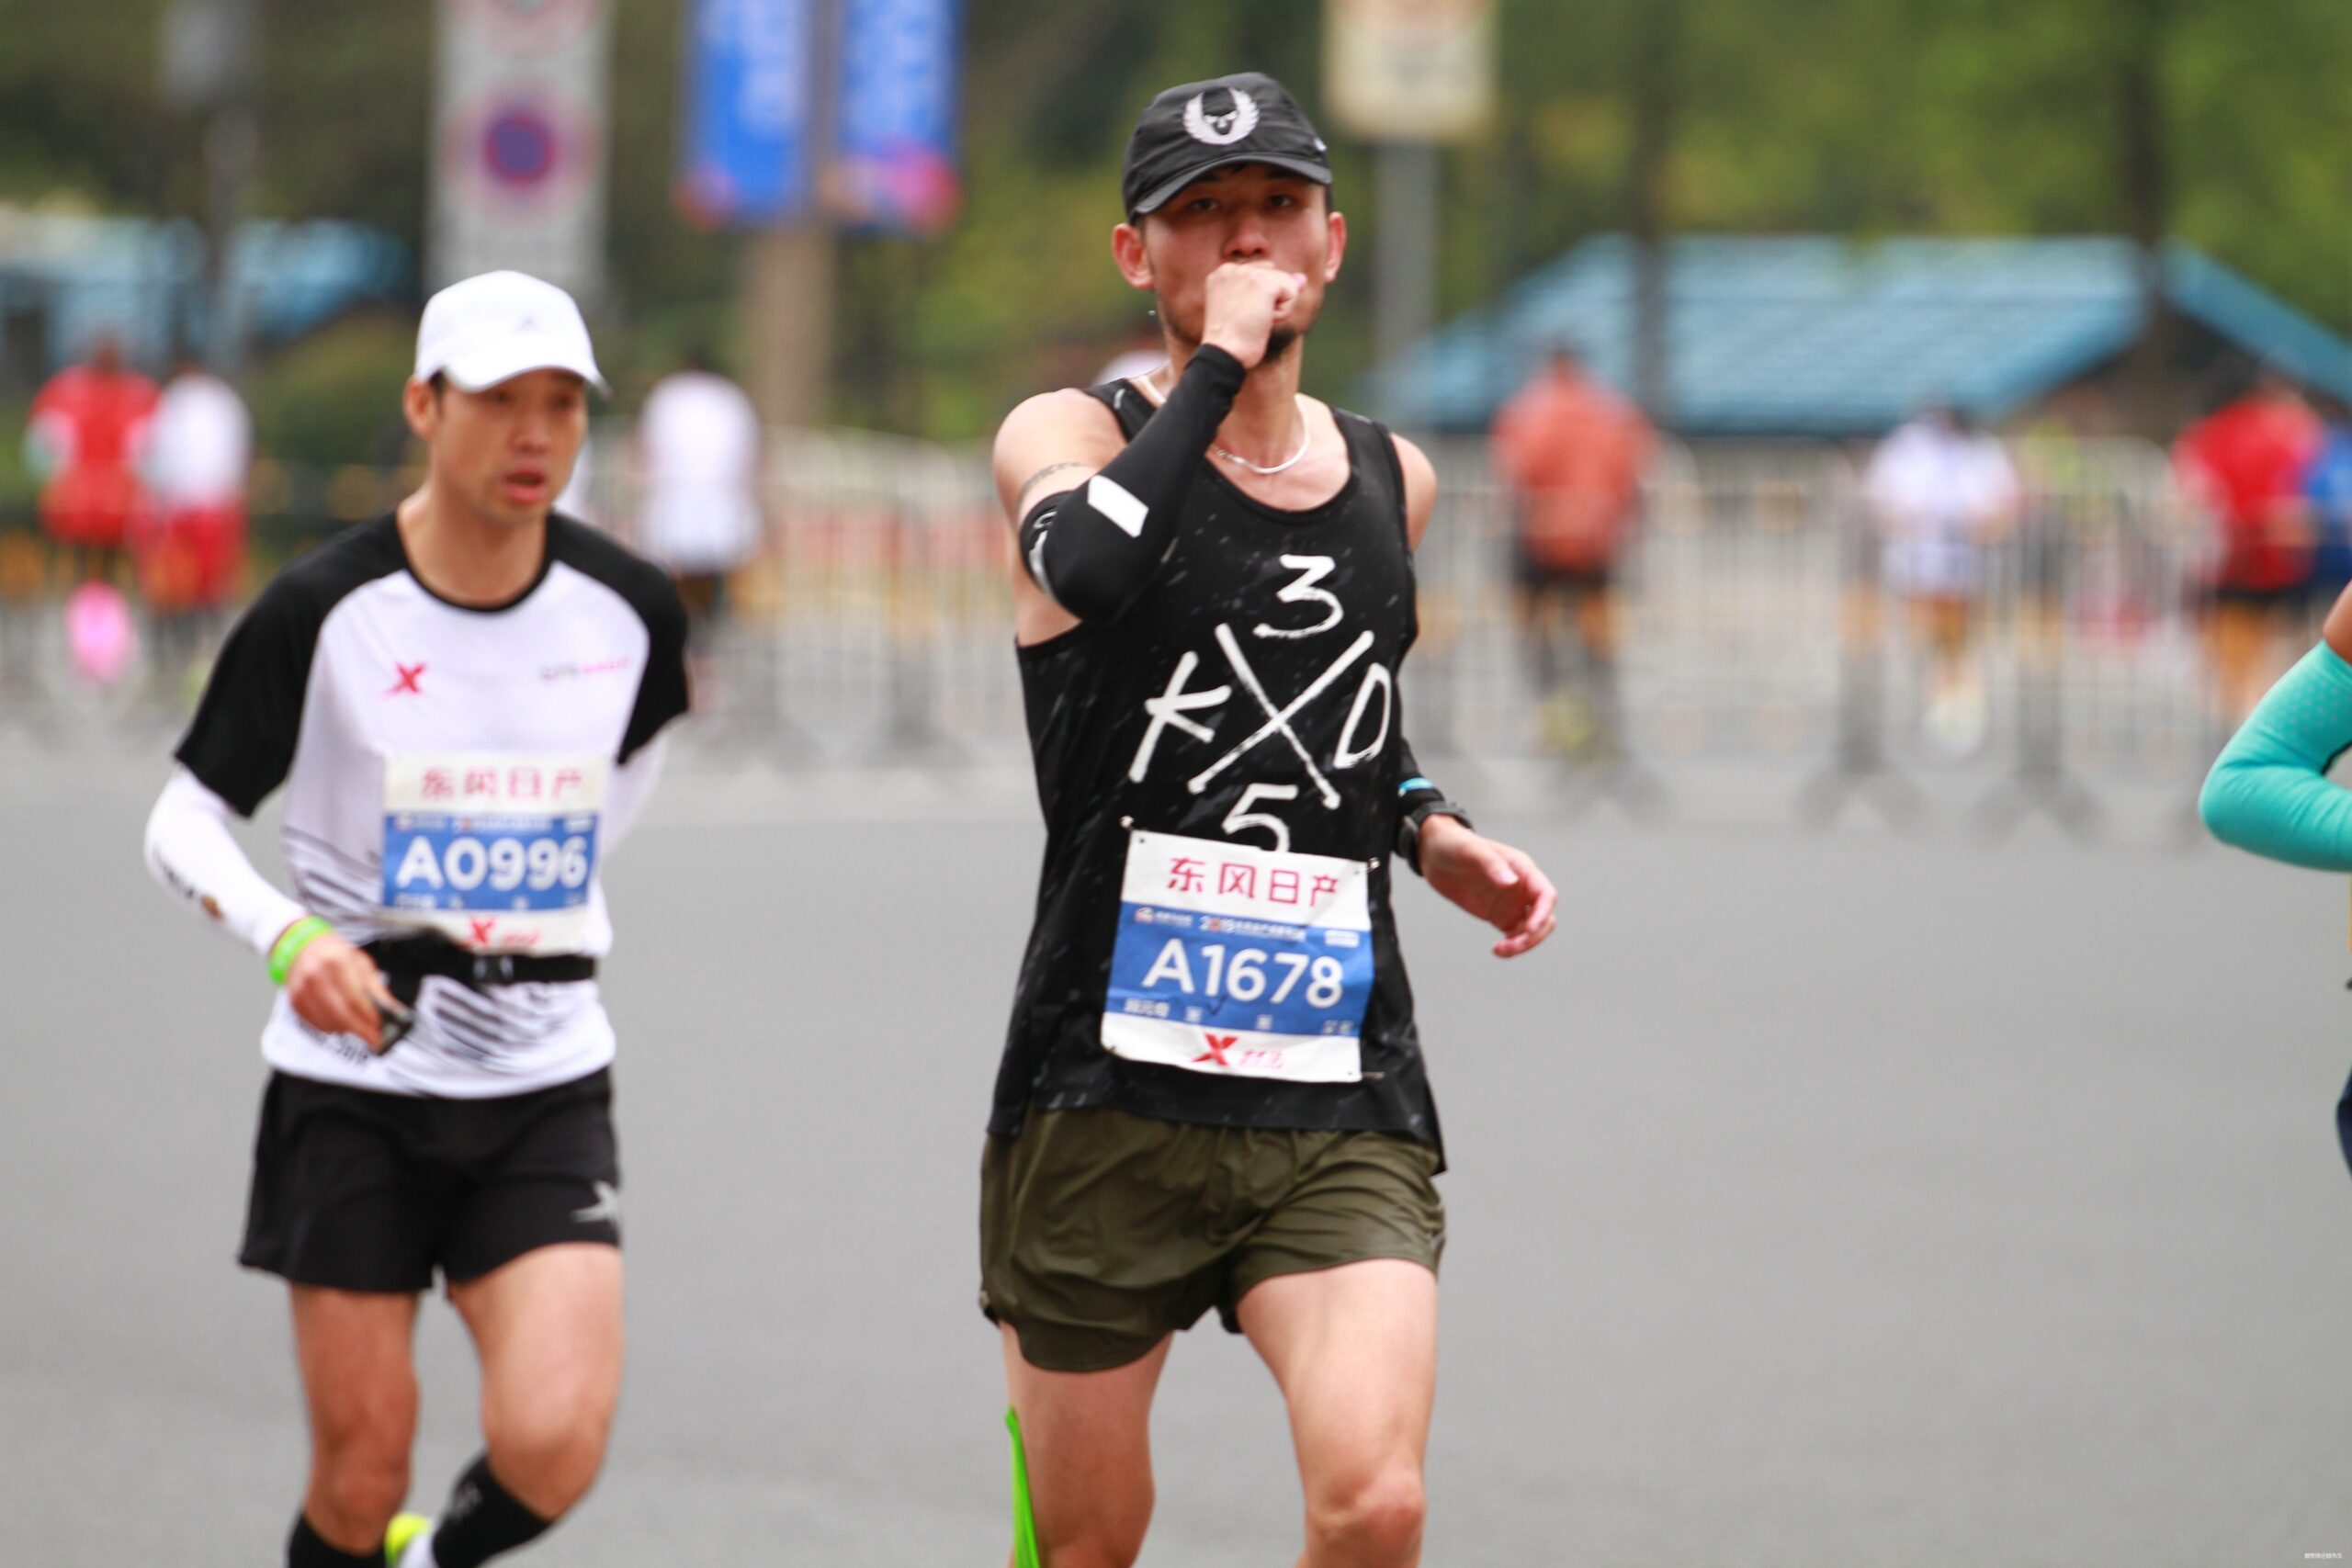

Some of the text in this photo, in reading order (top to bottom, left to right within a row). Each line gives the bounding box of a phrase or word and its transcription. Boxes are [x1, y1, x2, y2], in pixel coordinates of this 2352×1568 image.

[1253, 554, 1343, 638] 3
[395, 836, 588, 891] A0996
[1167, 857, 1340, 907] 东风日产
[1141, 937, 1343, 1009] A1678
